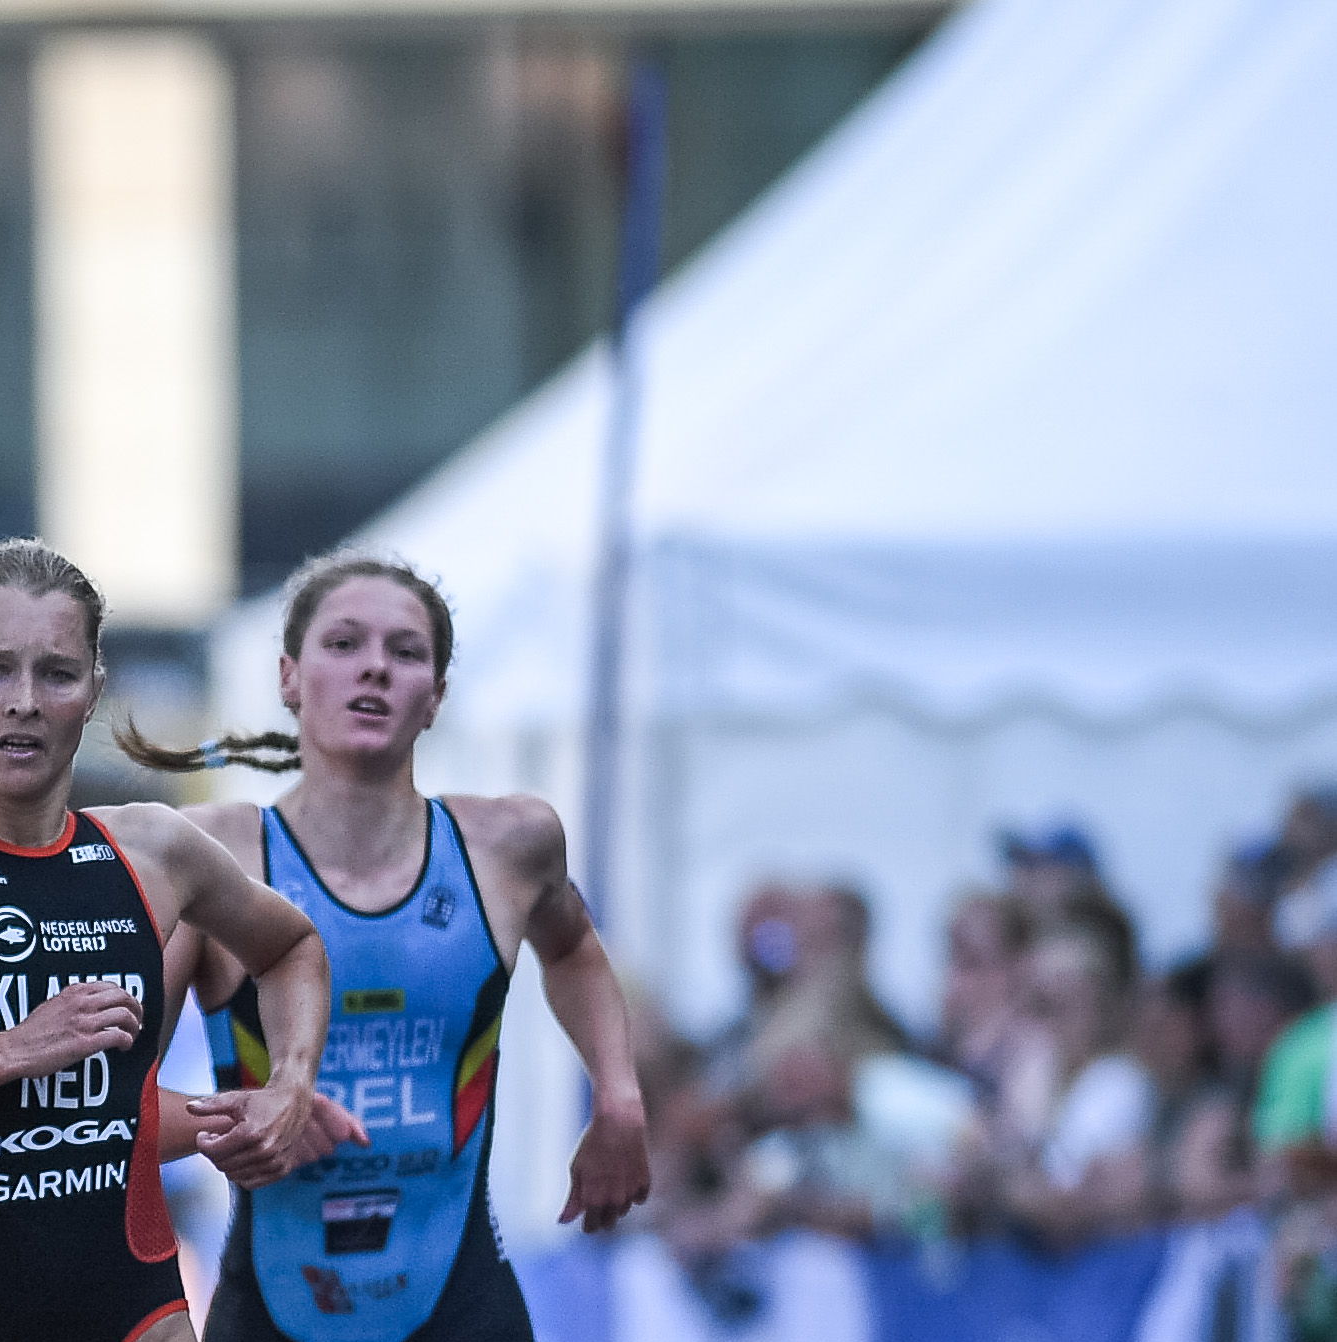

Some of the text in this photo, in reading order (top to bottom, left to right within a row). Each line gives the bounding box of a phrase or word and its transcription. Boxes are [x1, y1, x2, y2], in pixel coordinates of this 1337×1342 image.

[39, 919, 137, 936] NEDERLANDSE
[41, 936, 107, 952] LOTERIJ
[323, 1017, 445, 1073] ERMEYLEN
